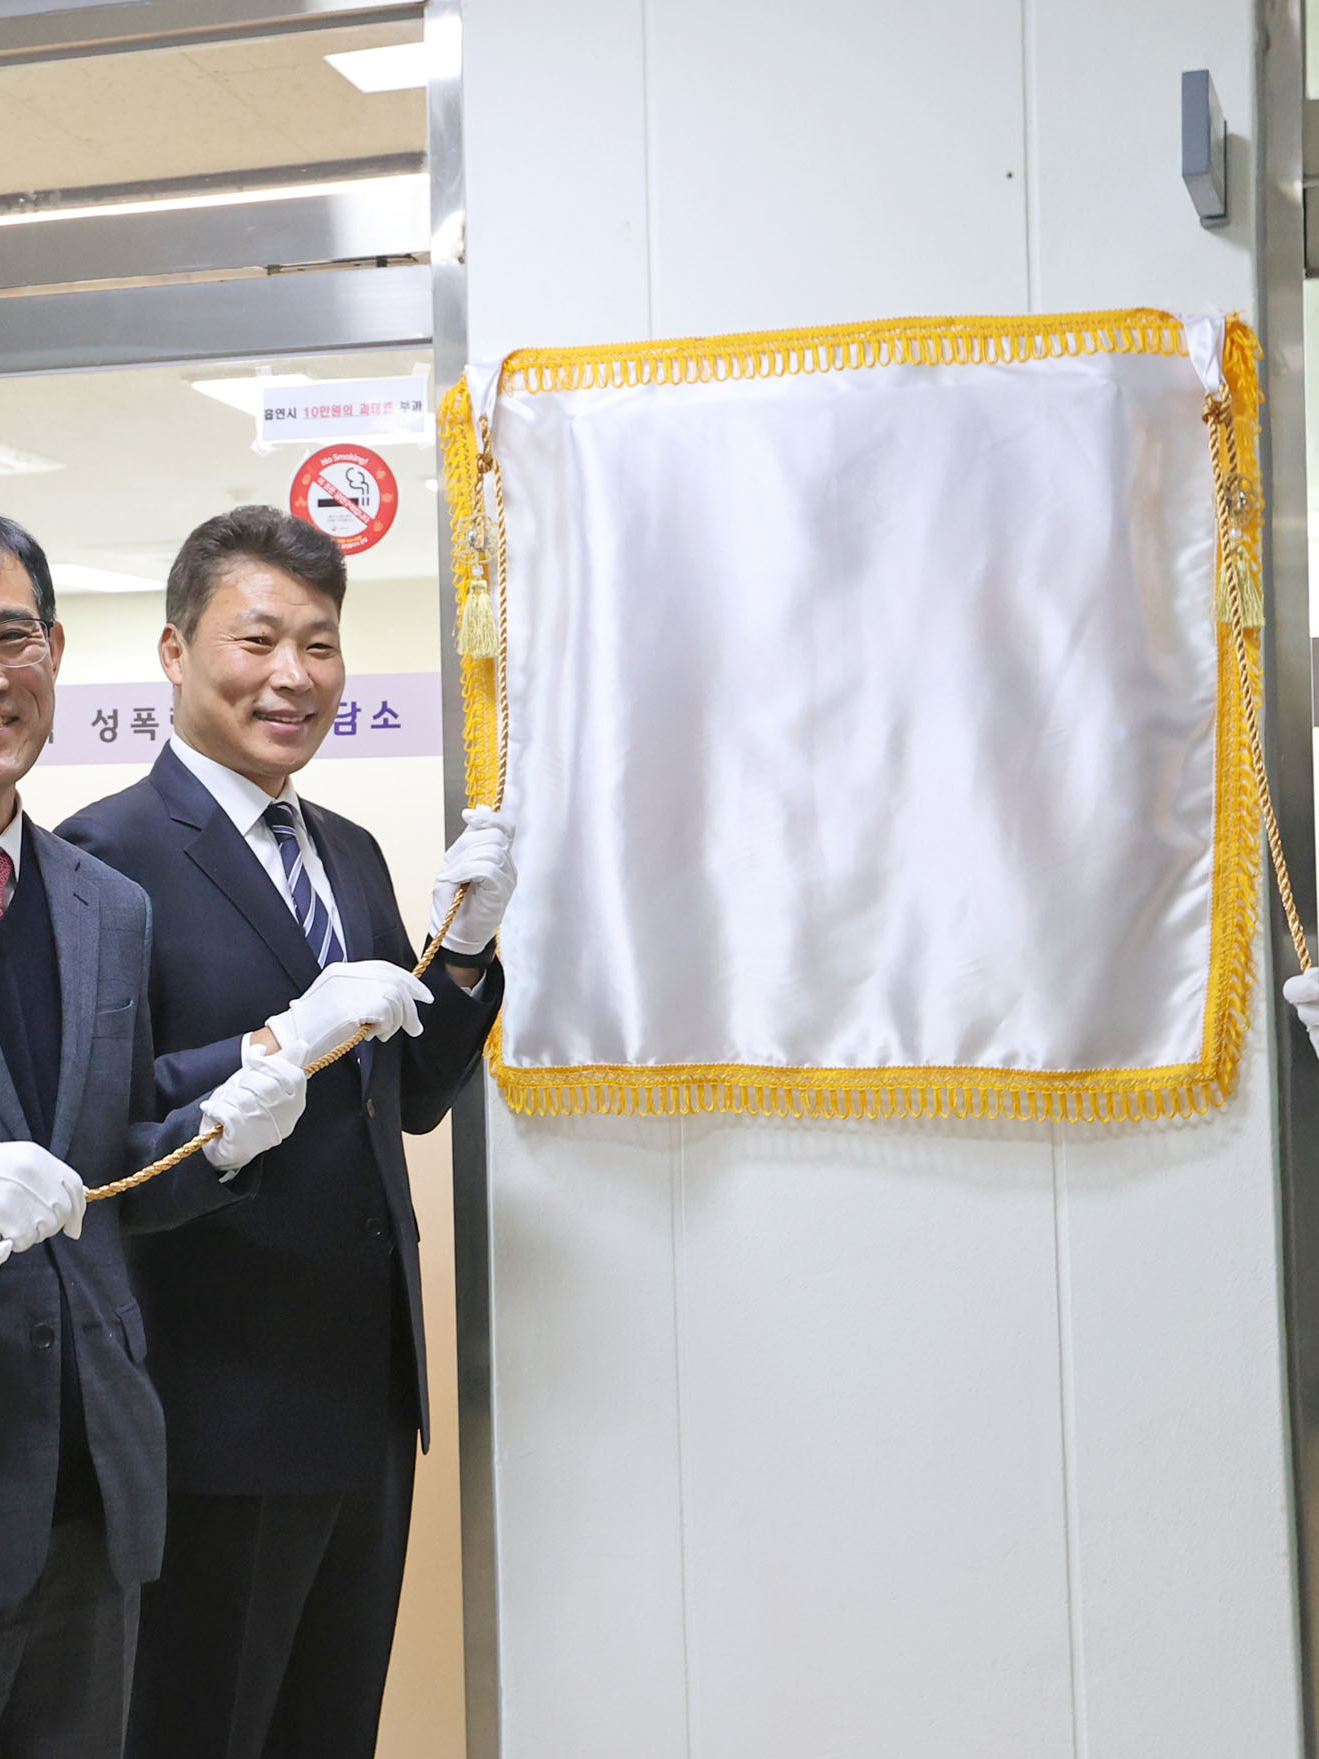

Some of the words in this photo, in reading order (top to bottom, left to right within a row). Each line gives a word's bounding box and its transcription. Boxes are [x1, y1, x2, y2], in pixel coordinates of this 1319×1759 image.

[321, 456, 333, 466] No
[91, 708, 174, 743] 성폭
[334, 700, 401, 736] 담소
